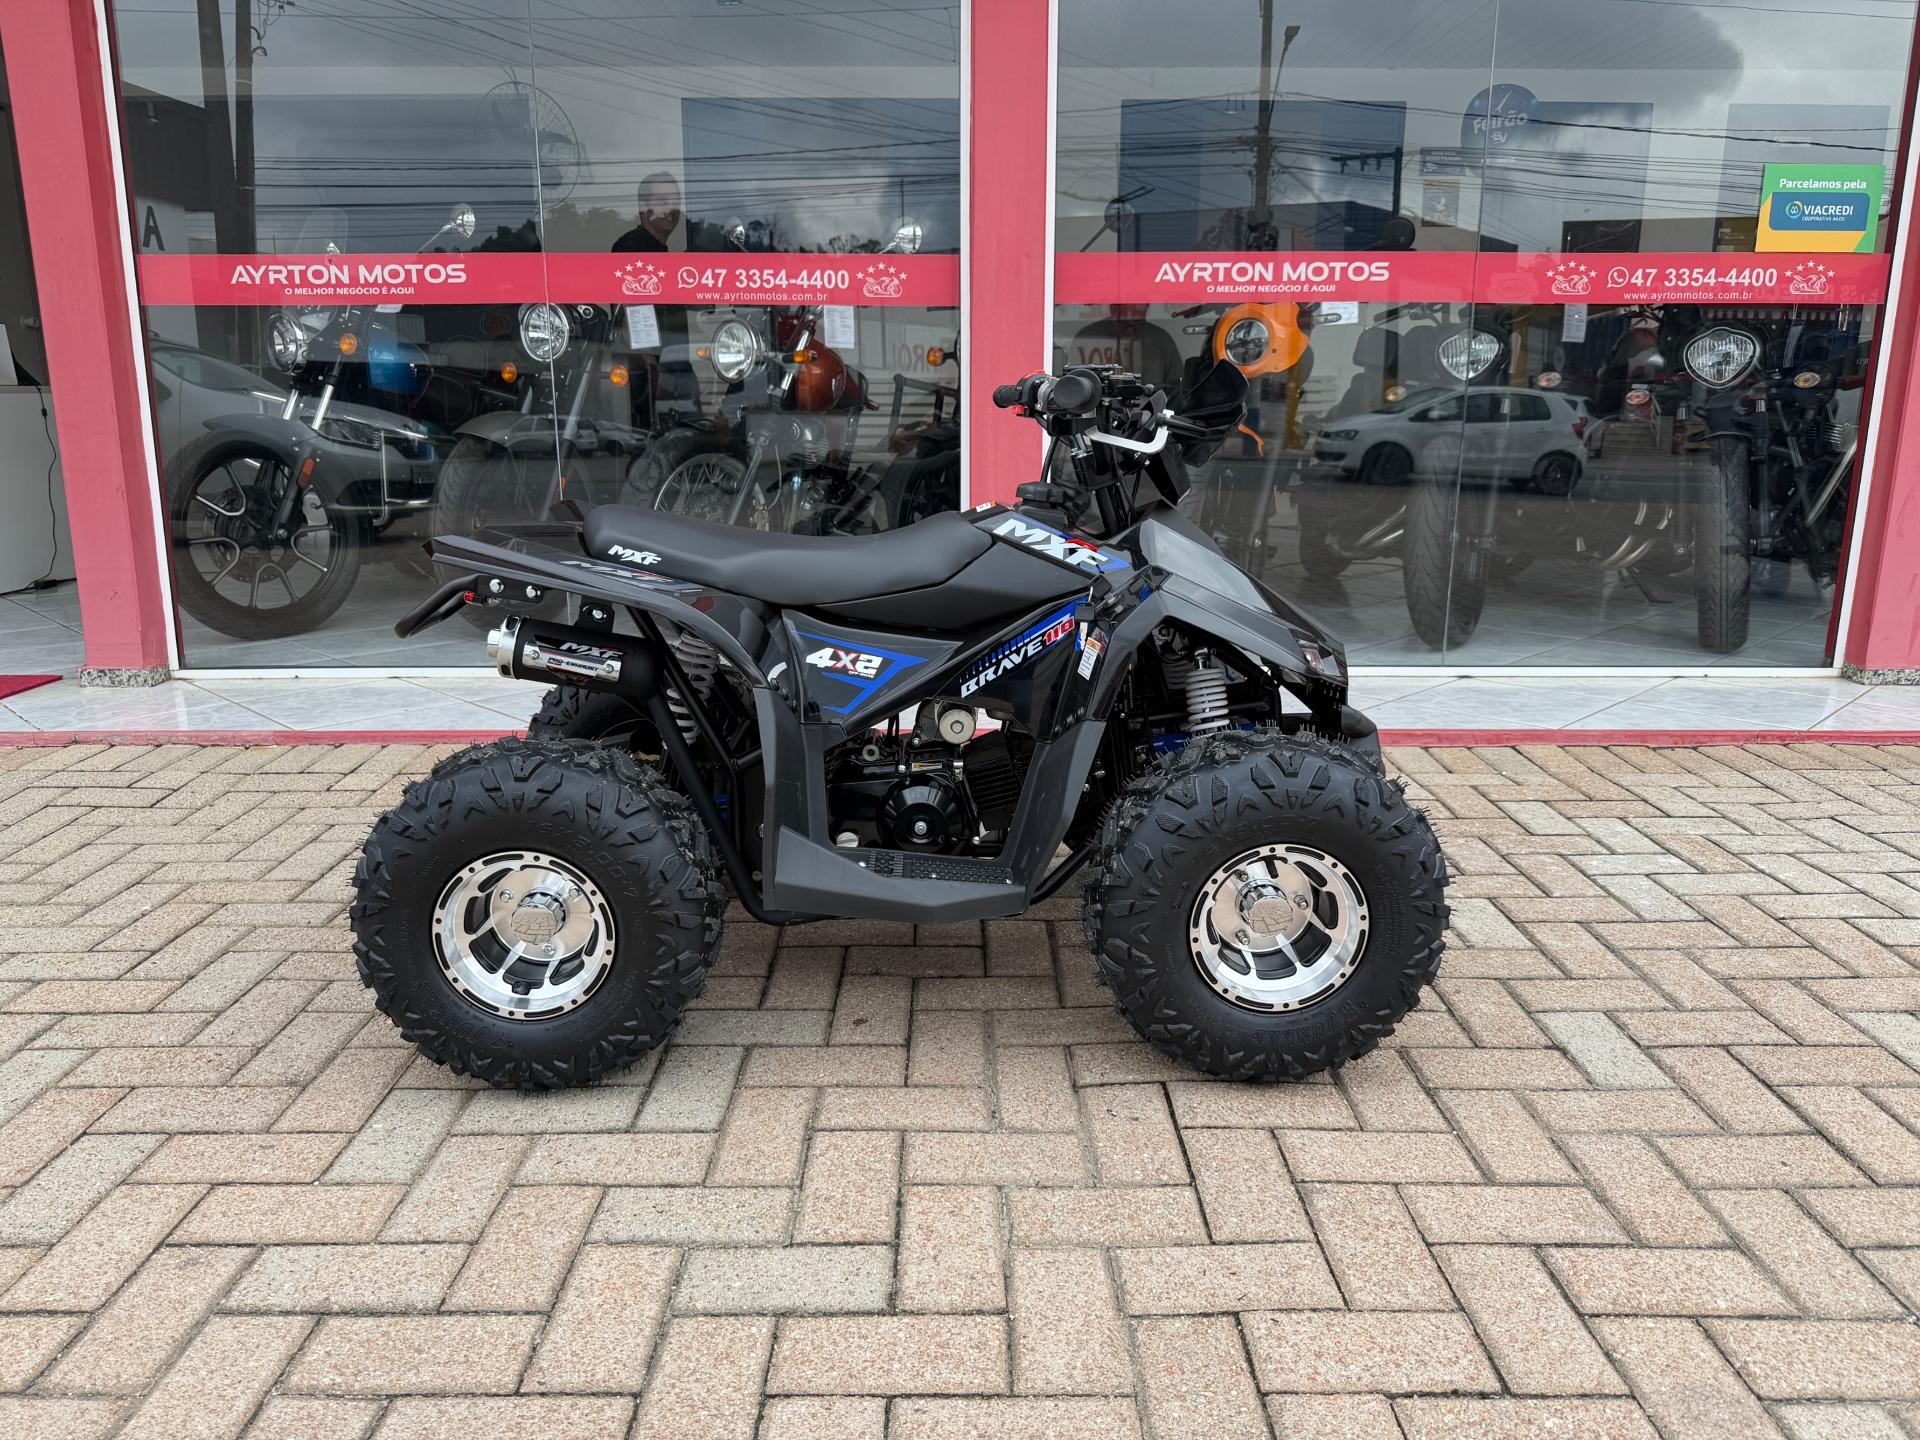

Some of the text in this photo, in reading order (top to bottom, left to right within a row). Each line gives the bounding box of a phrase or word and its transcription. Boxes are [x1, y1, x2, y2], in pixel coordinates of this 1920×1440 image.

[1779, 178, 1867, 190] Parcelamos pela
[1803, 205, 1854, 215] VIACREDI
[230, 264, 467, 285] AYRTON MOTOS
[701, 268, 850, 289] 47 3354-4400
[1154, 262, 1390, 282] AYRTON MOTOS
[1630, 268, 1778, 287] 47 3354-4400
[285, 287, 293, 295] O
[295, 287, 334, 295] MELHOR
[337, 286, 380, 295] NEGÓCIO
[390, 287, 415, 295] AQUI
[696, 291, 828, 301] www.ayrtonmotos.com.br
[1206, 285, 1214, 293] O
[1216, 284, 1257, 293] MELHOR
[1258, 283, 1302, 293] NEGÓCIO
[1310, 284, 1336, 292] AQUI
[1624, 291, 1753, 301] www.ayrtonmotos.com.br
[993, 518, 1109, 566] MXF
[608, 544, 663, 566] MXF
[559, 642, 624, 658] MXF
[960, 636, 1043, 699] BRAVE
[1042, 616, 1075, 646] 110
[805, 647, 884, 675] 4X2
